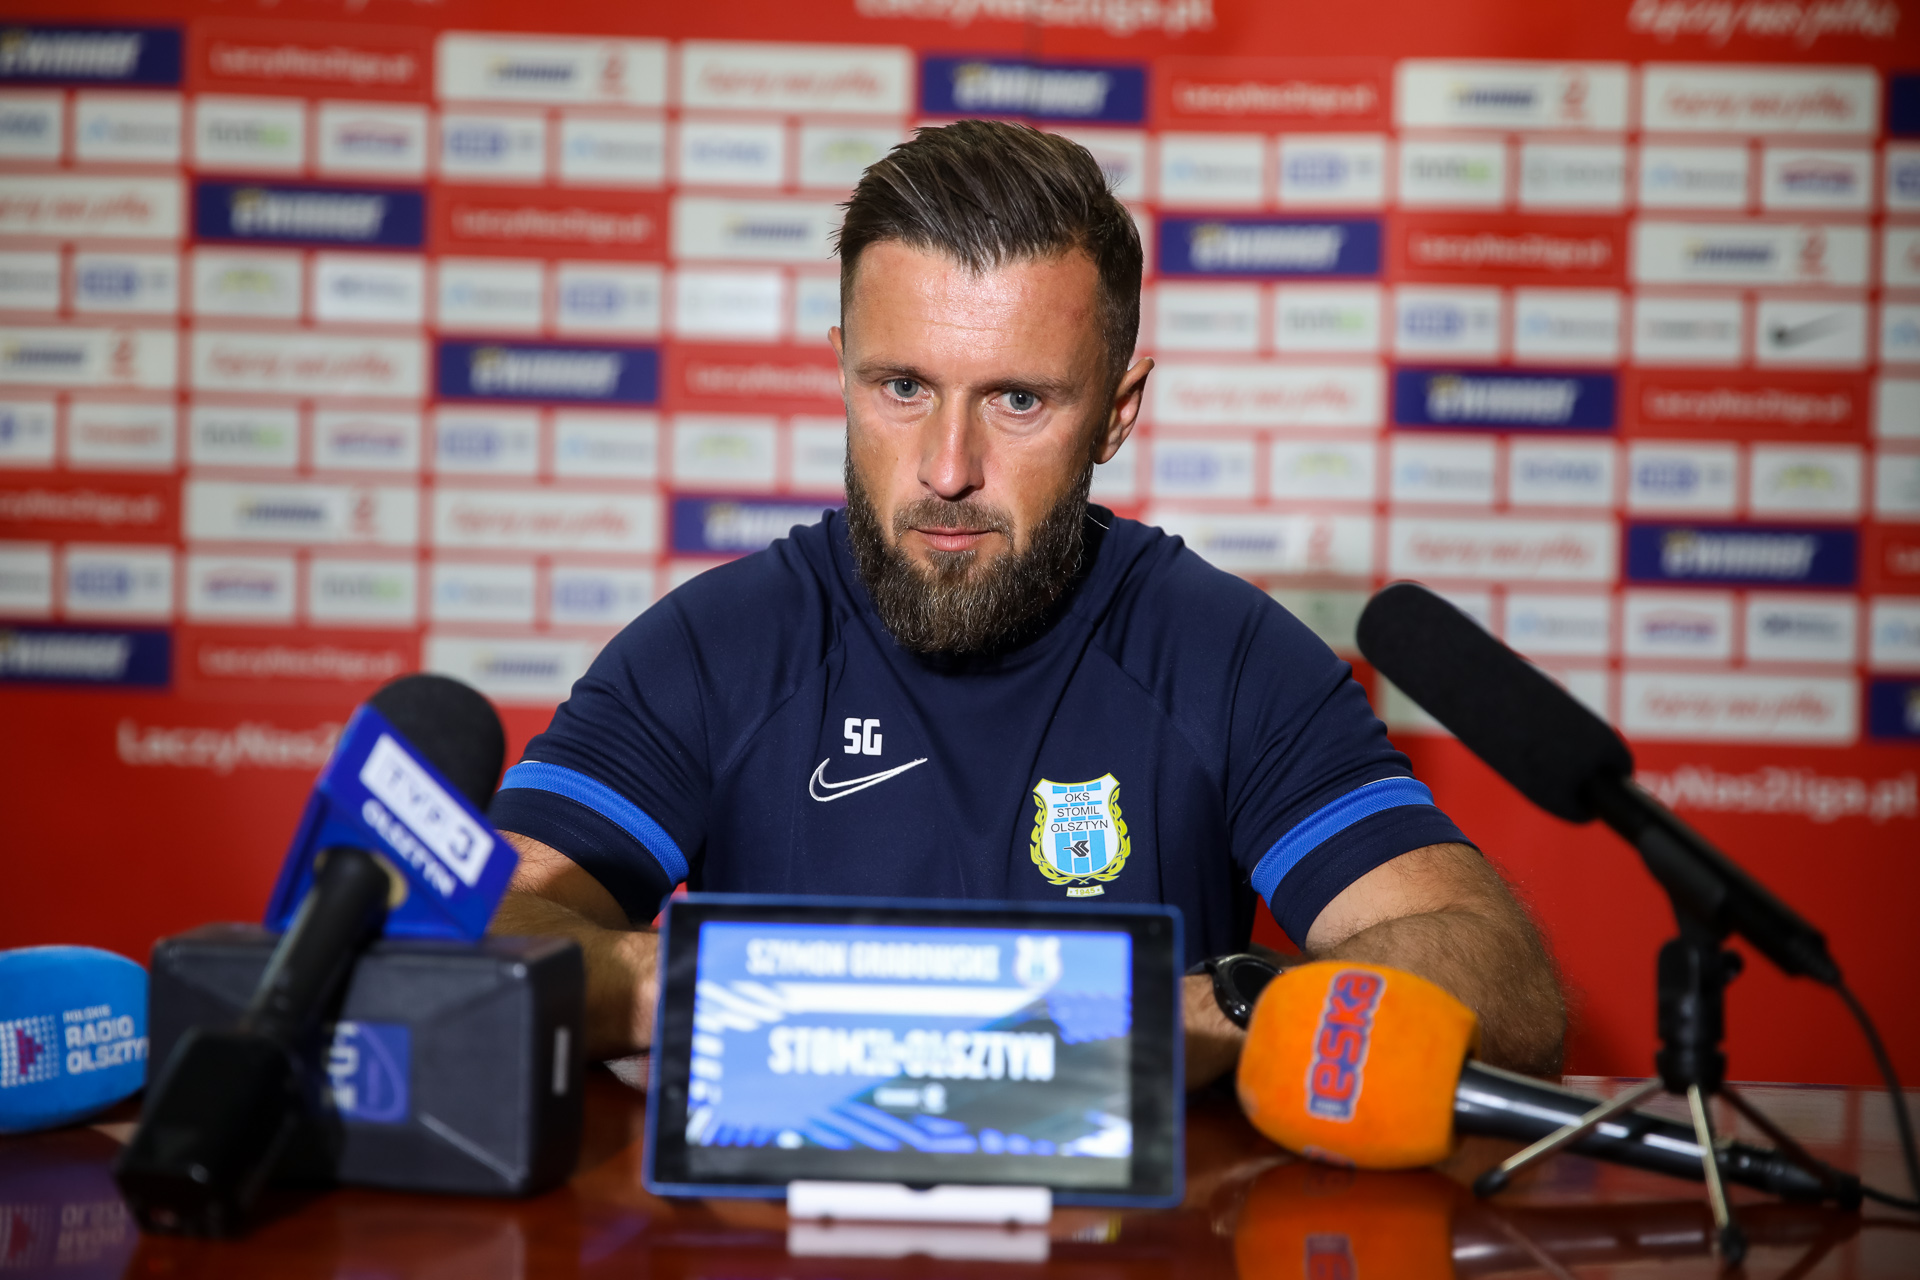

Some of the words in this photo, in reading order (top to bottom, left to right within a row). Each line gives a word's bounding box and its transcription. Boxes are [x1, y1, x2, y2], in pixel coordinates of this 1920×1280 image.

[843, 717, 883, 756] SG
[1064, 792, 1090, 803] OKS
[1057, 805, 1100, 818] STOMIL
[1050, 819, 1109, 833] OLSZTYN
[1074, 887, 1096, 896] 1945
[65, 1014, 135, 1050] RADIO
